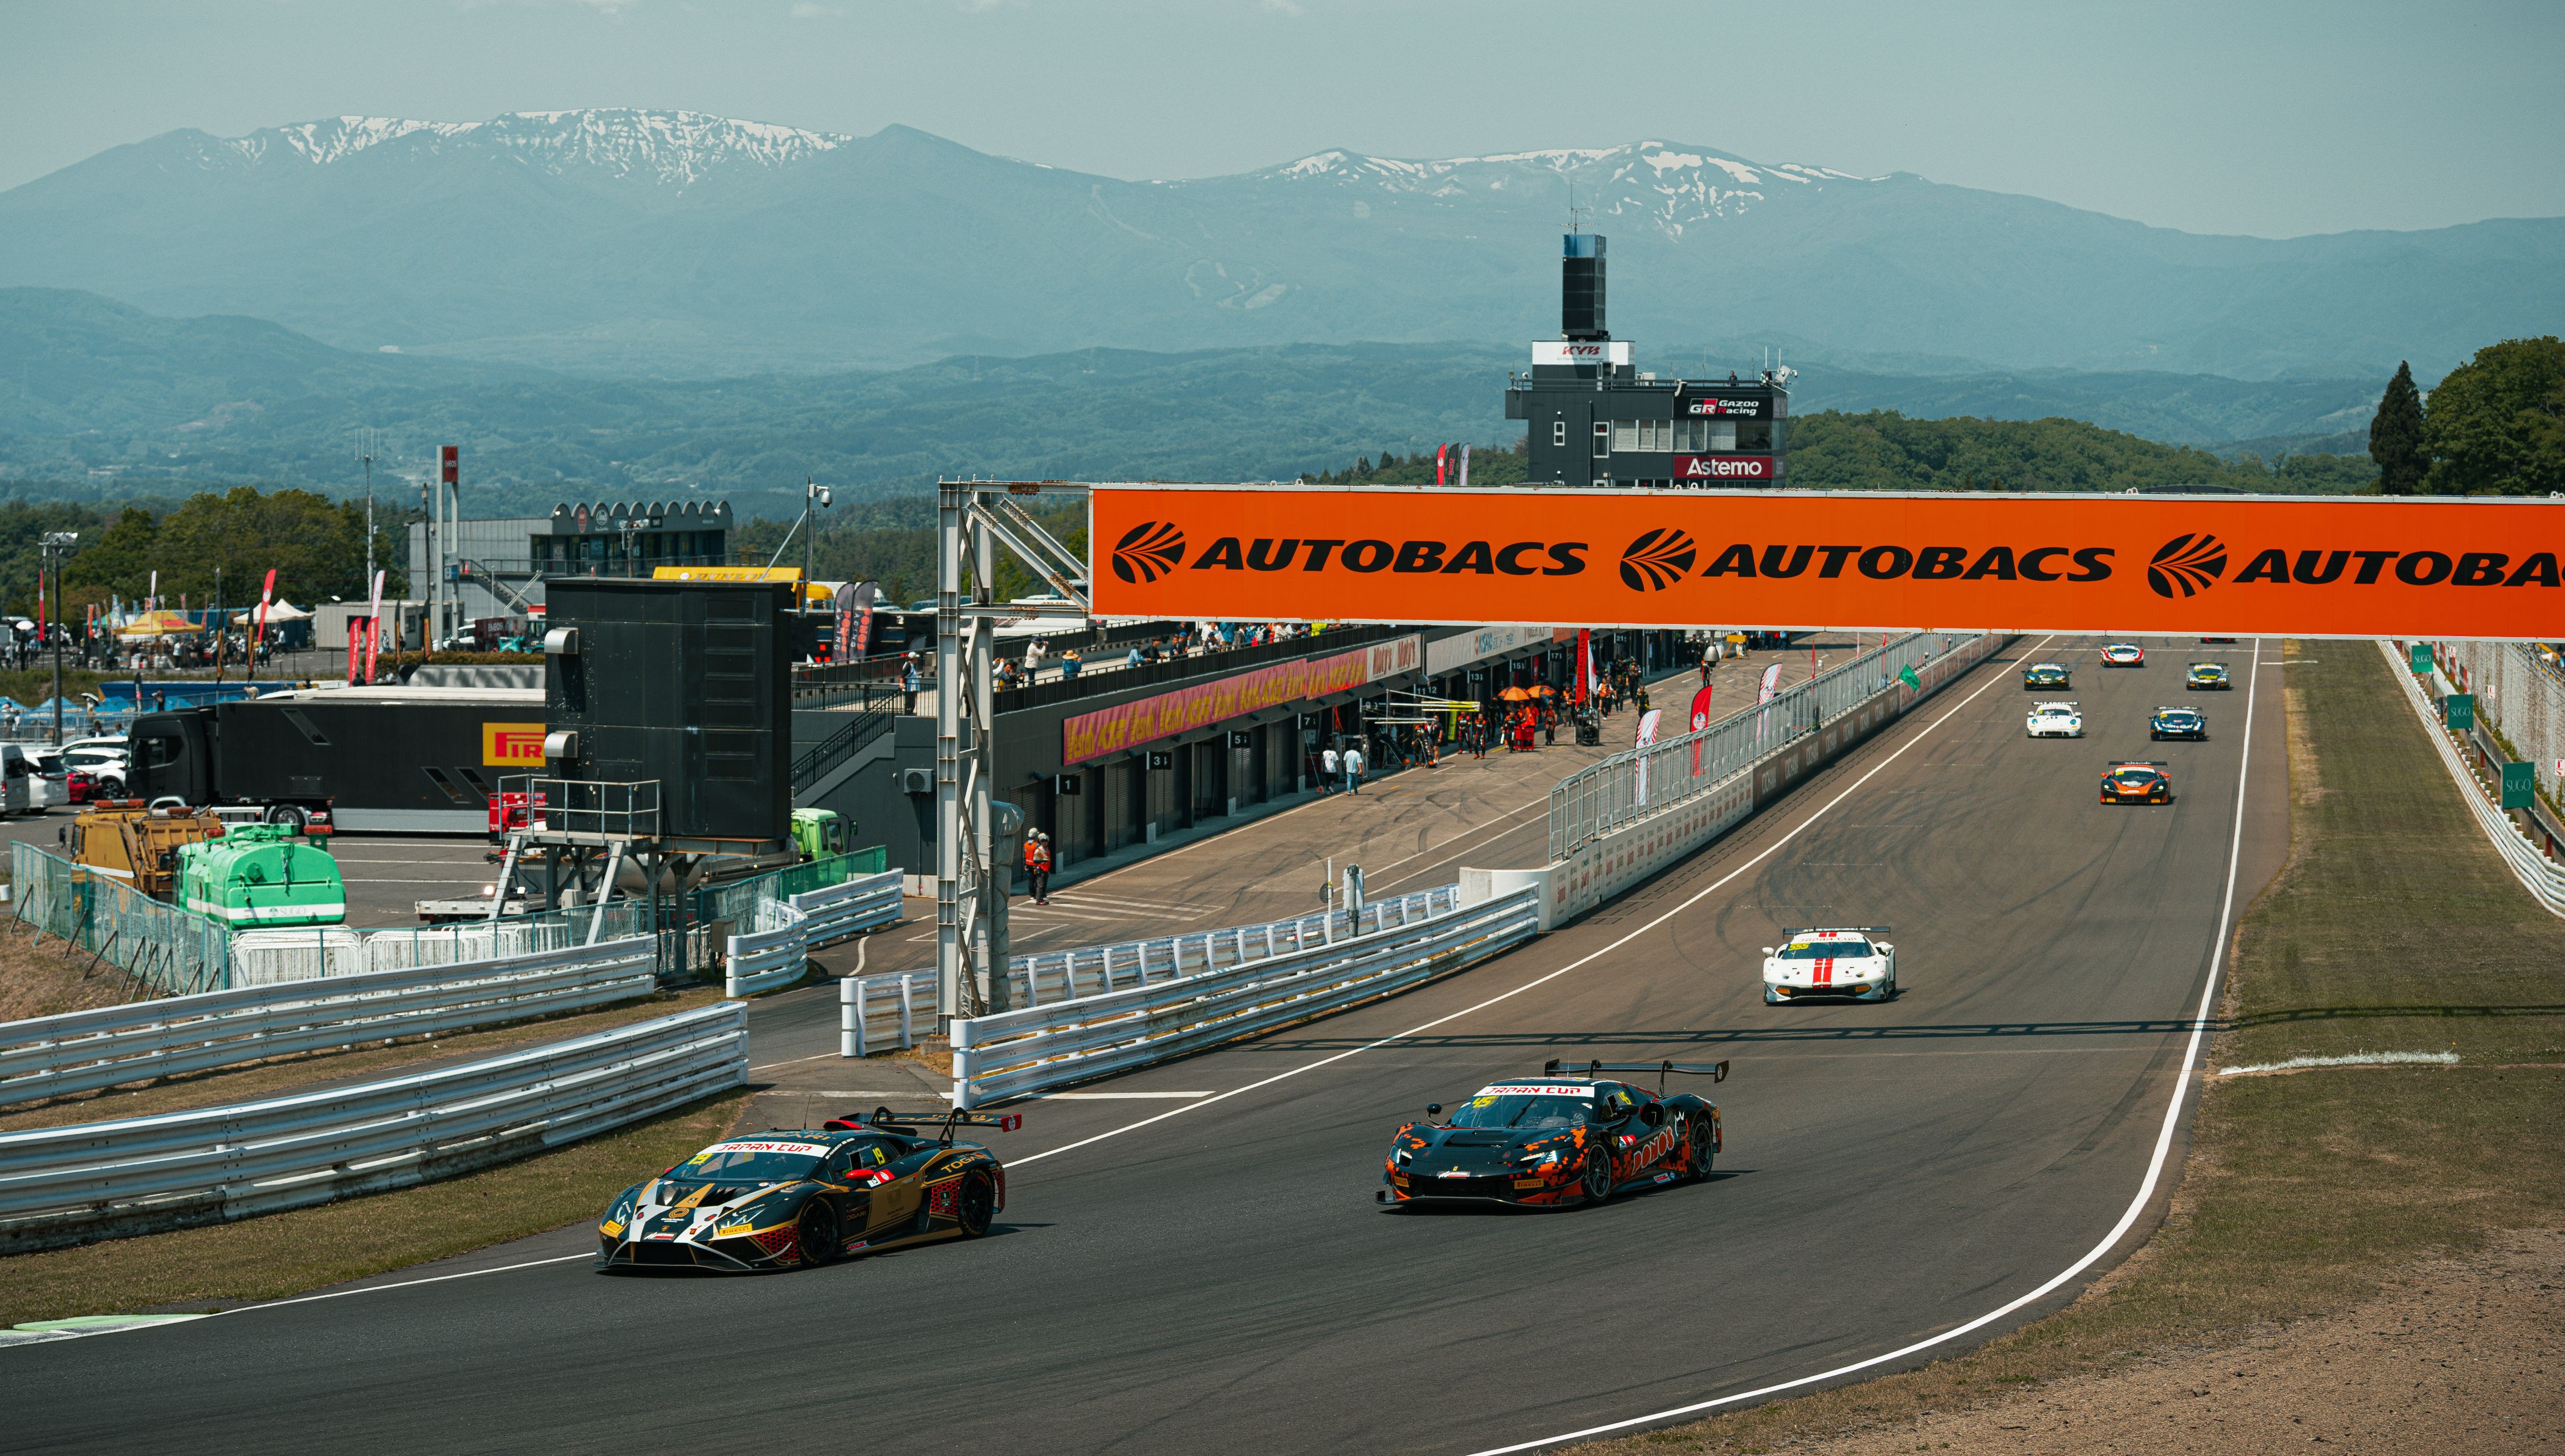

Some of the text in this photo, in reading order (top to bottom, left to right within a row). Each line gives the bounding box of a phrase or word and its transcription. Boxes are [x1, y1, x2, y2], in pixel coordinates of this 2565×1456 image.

[1562, 346, 1600, 354] KYB
[1689, 404, 1715, 413] GR
[1717, 407, 1756, 416] Racing
[1687, 458, 1762, 475] Astemo
[1191, 537, 1588, 576] AUTOBACS
[1701, 544, 2114, 581] AUTOBACS
[2233, 549, 2565, 587] AUTOBA
[2415, 654, 2431, 663] SUGO
[2451, 706, 2470, 717] SUGO
[1234, 735, 1241, 744] 5
[1154, 756, 1160, 765] 3
[1065, 780, 1070, 789] 1
[2506, 778, 2531, 792] SUGO
[280, 906, 306, 917] SUGO
[1788, 943, 1811, 951] 555
[1472, 1095, 1497, 1108] 45
[1618, 1091, 1631, 1105] 45
[872, 1147, 885, 1165] 19
[1631, 1126, 1675, 1176] PONOS
[687, 1153, 712, 1165] 19
[1517, 1179, 1542, 1188] PIRELLI
[722, 1226, 750, 1234] PIRELLI
